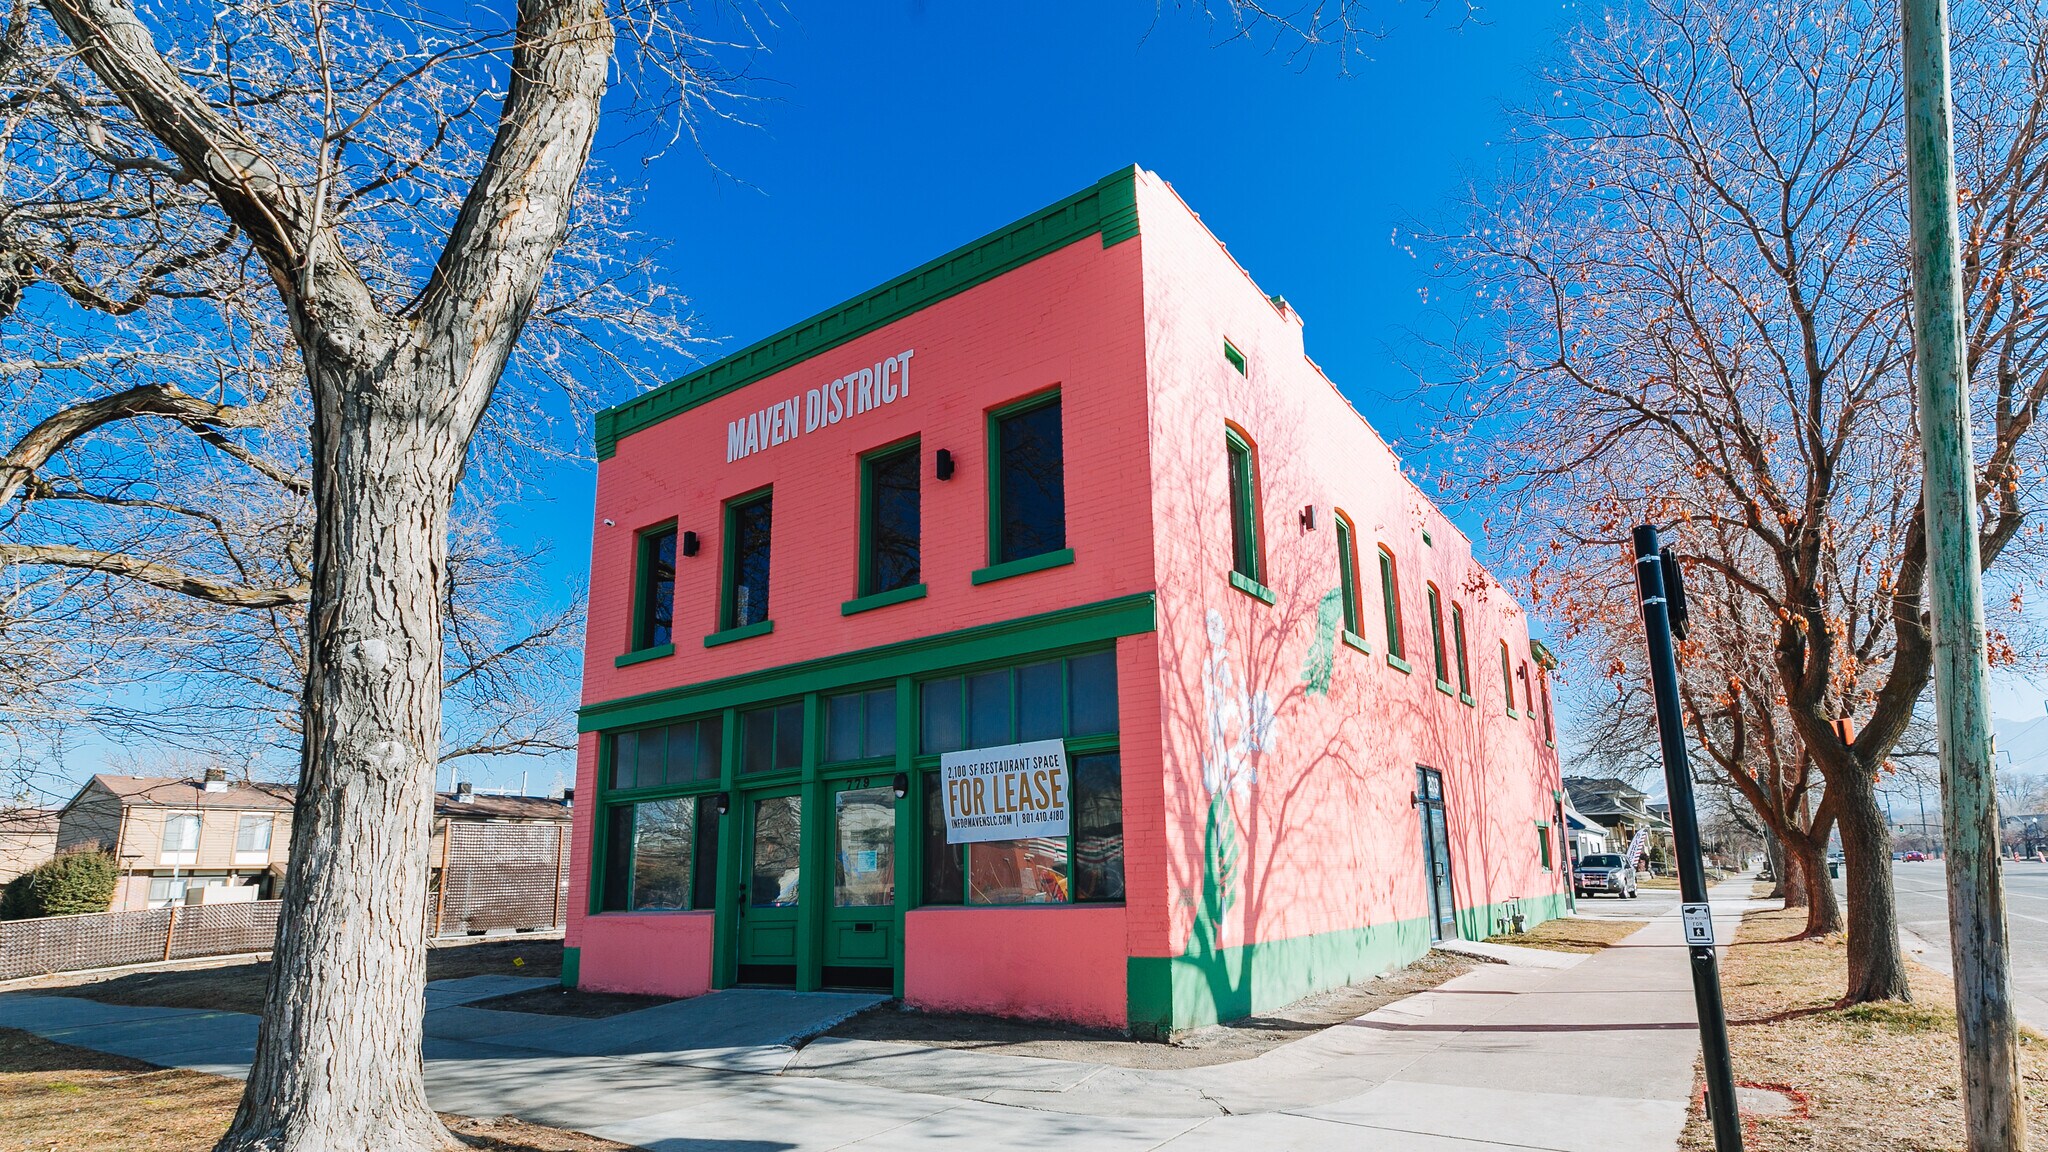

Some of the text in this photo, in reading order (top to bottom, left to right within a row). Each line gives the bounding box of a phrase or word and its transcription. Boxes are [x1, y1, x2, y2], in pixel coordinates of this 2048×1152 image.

[727, 348, 914, 464] MAVEN DISTRICT
[947, 754, 1060, 779] 2,100 SF RESTAURANT SPACE
[847, 776, 870, 791] 779
[948, 768, 1065, 818] FOR LEASE
[951, 814, 1013, 830] INFO@MAVENSLC.COM
[1021, 810, 1064, 825] 801.410.4180
